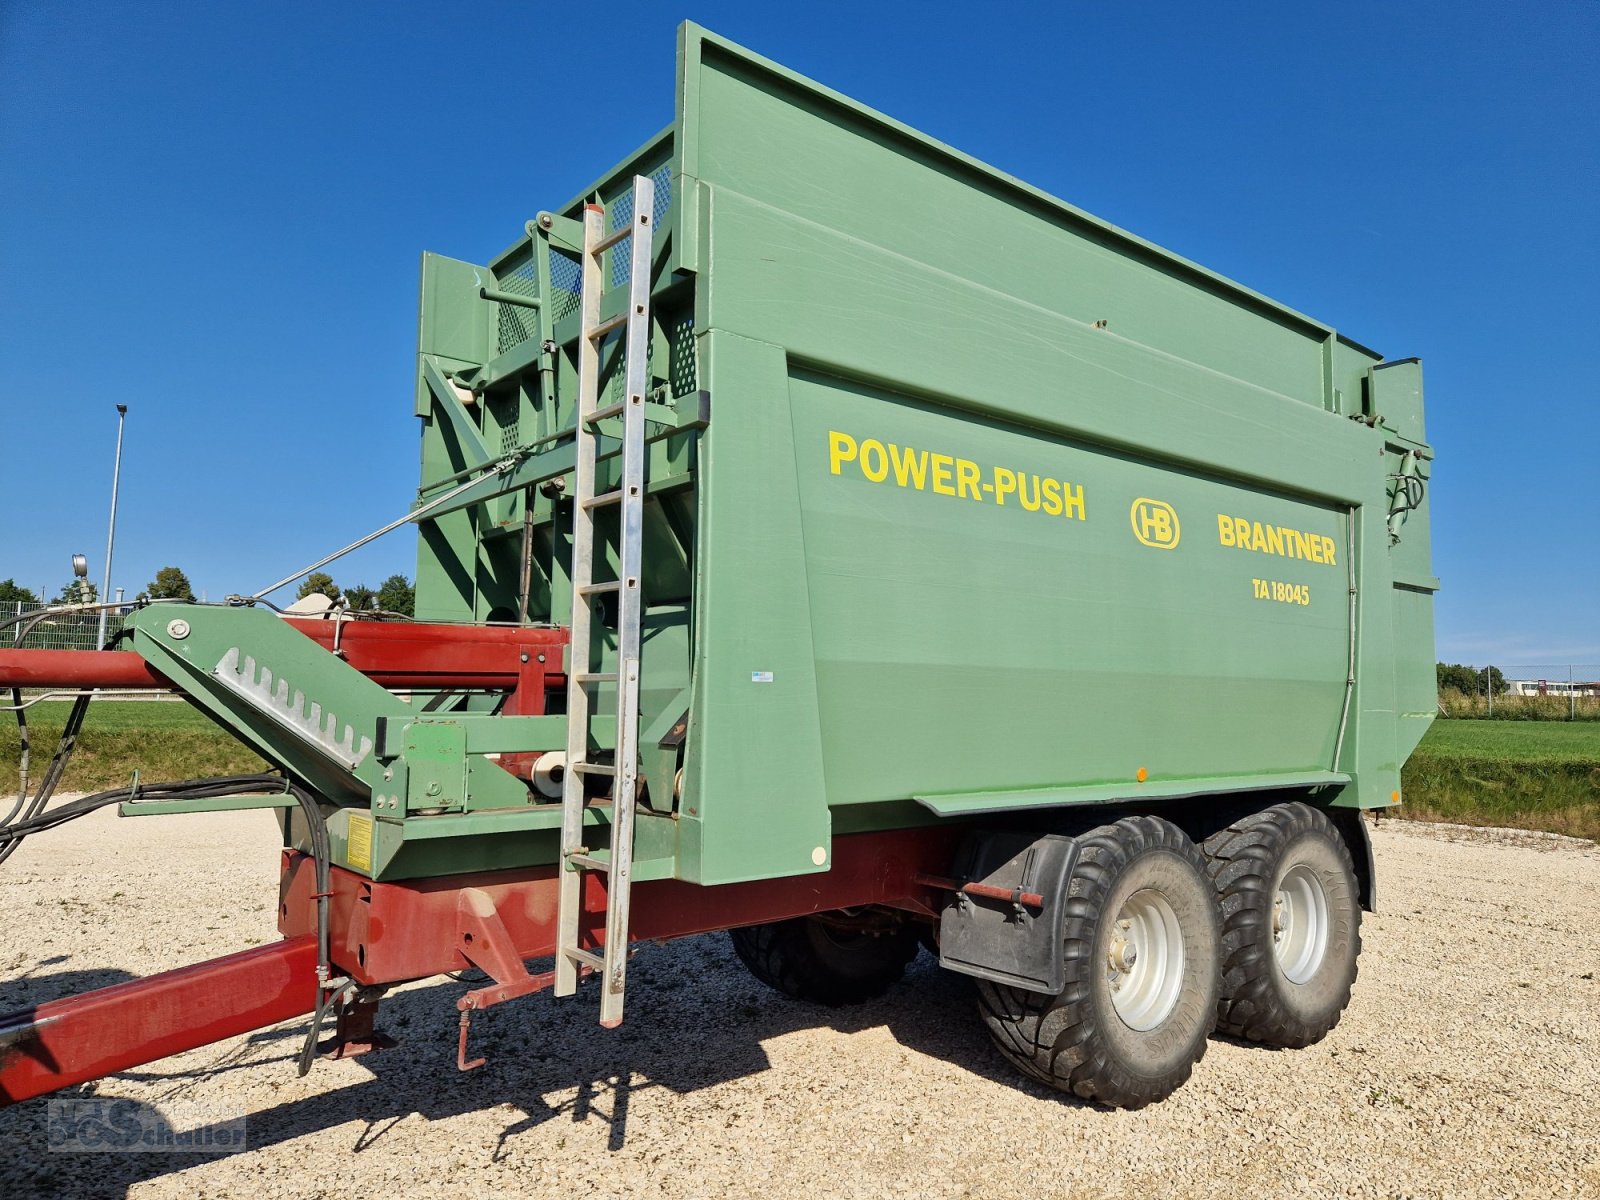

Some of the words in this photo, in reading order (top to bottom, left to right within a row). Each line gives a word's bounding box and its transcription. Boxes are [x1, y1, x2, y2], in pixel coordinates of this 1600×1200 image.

[828, 430, 1086, 521] POWER-PUSH
[1140, 505, 1172, 542] HB
[1217, 513, 1337, 566] BRANTNER
[1252, 578, 1270, 600] TA
[1271, 581, 1310, 606] 18045
